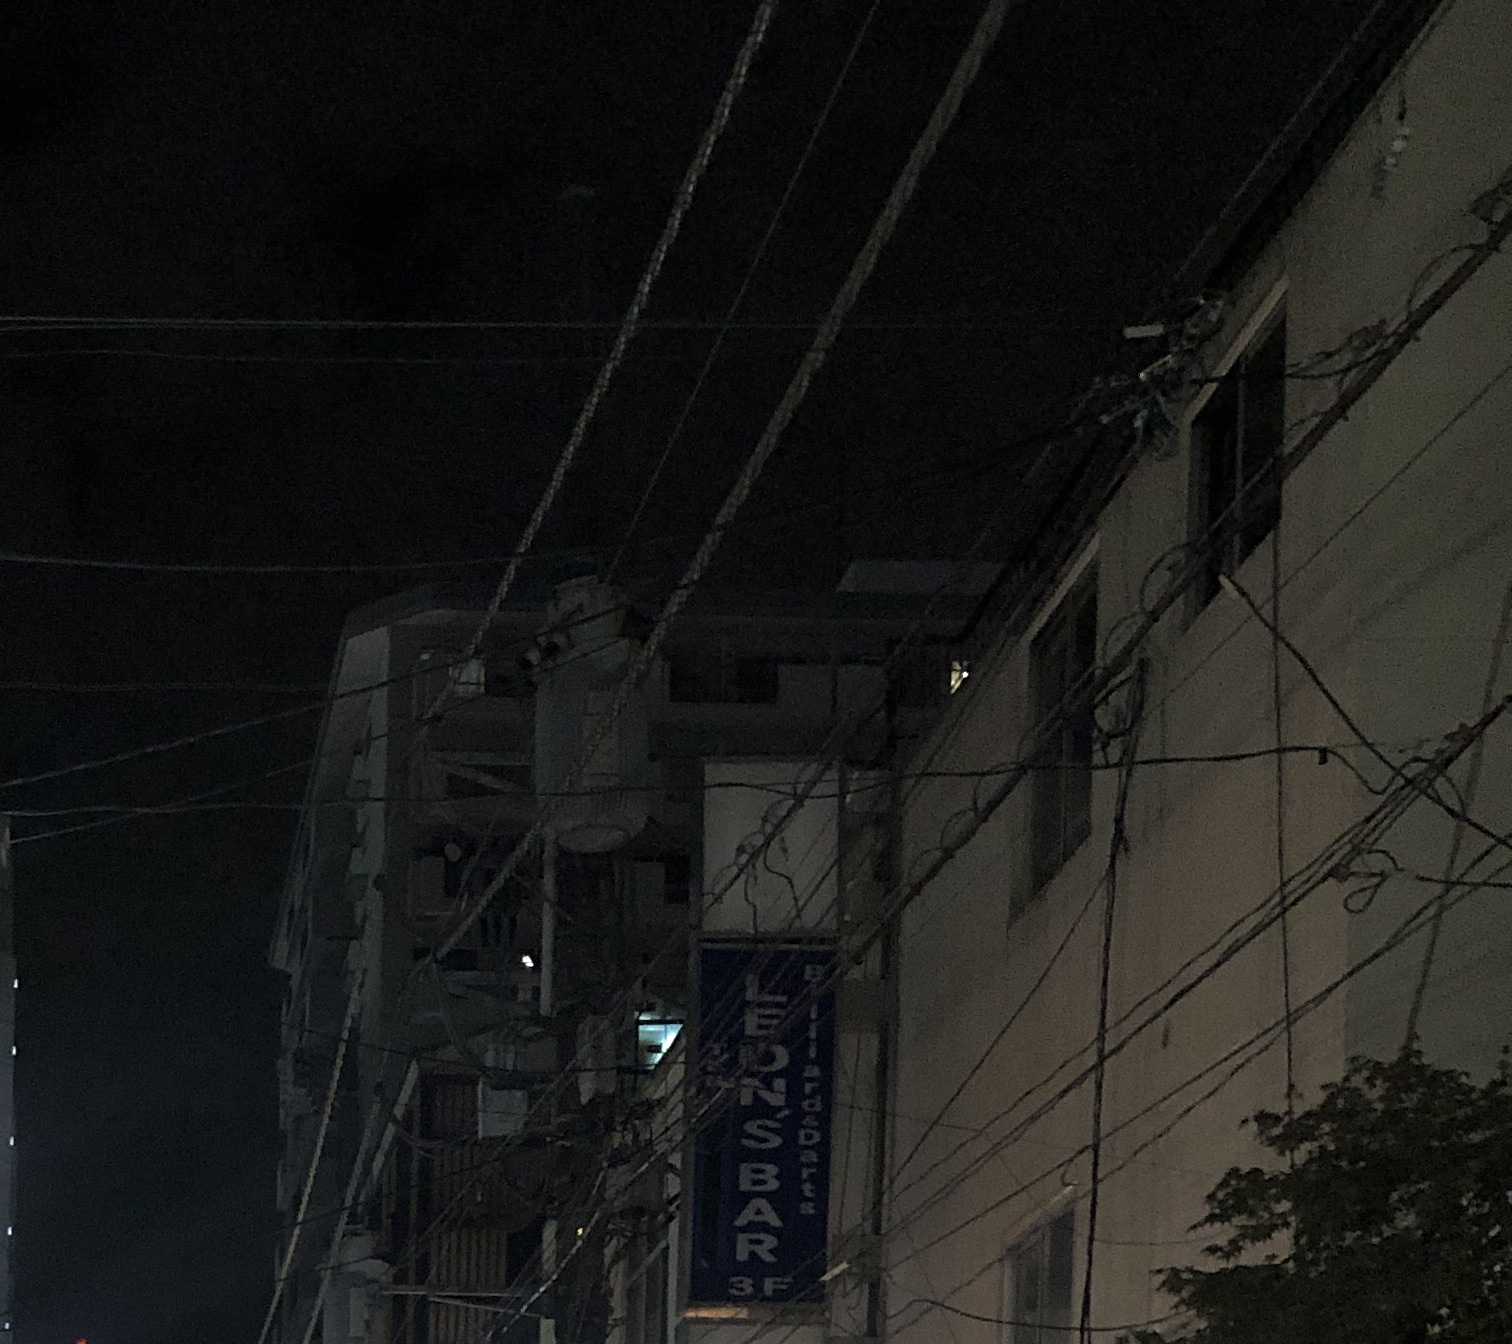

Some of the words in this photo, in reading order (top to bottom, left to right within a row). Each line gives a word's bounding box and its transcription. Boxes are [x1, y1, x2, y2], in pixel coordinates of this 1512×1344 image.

[739, 974, 789, 1149] LEON'S
[735, 1165, 782, 1262] BAR
[727, 1275, 793, 1298] 3F
